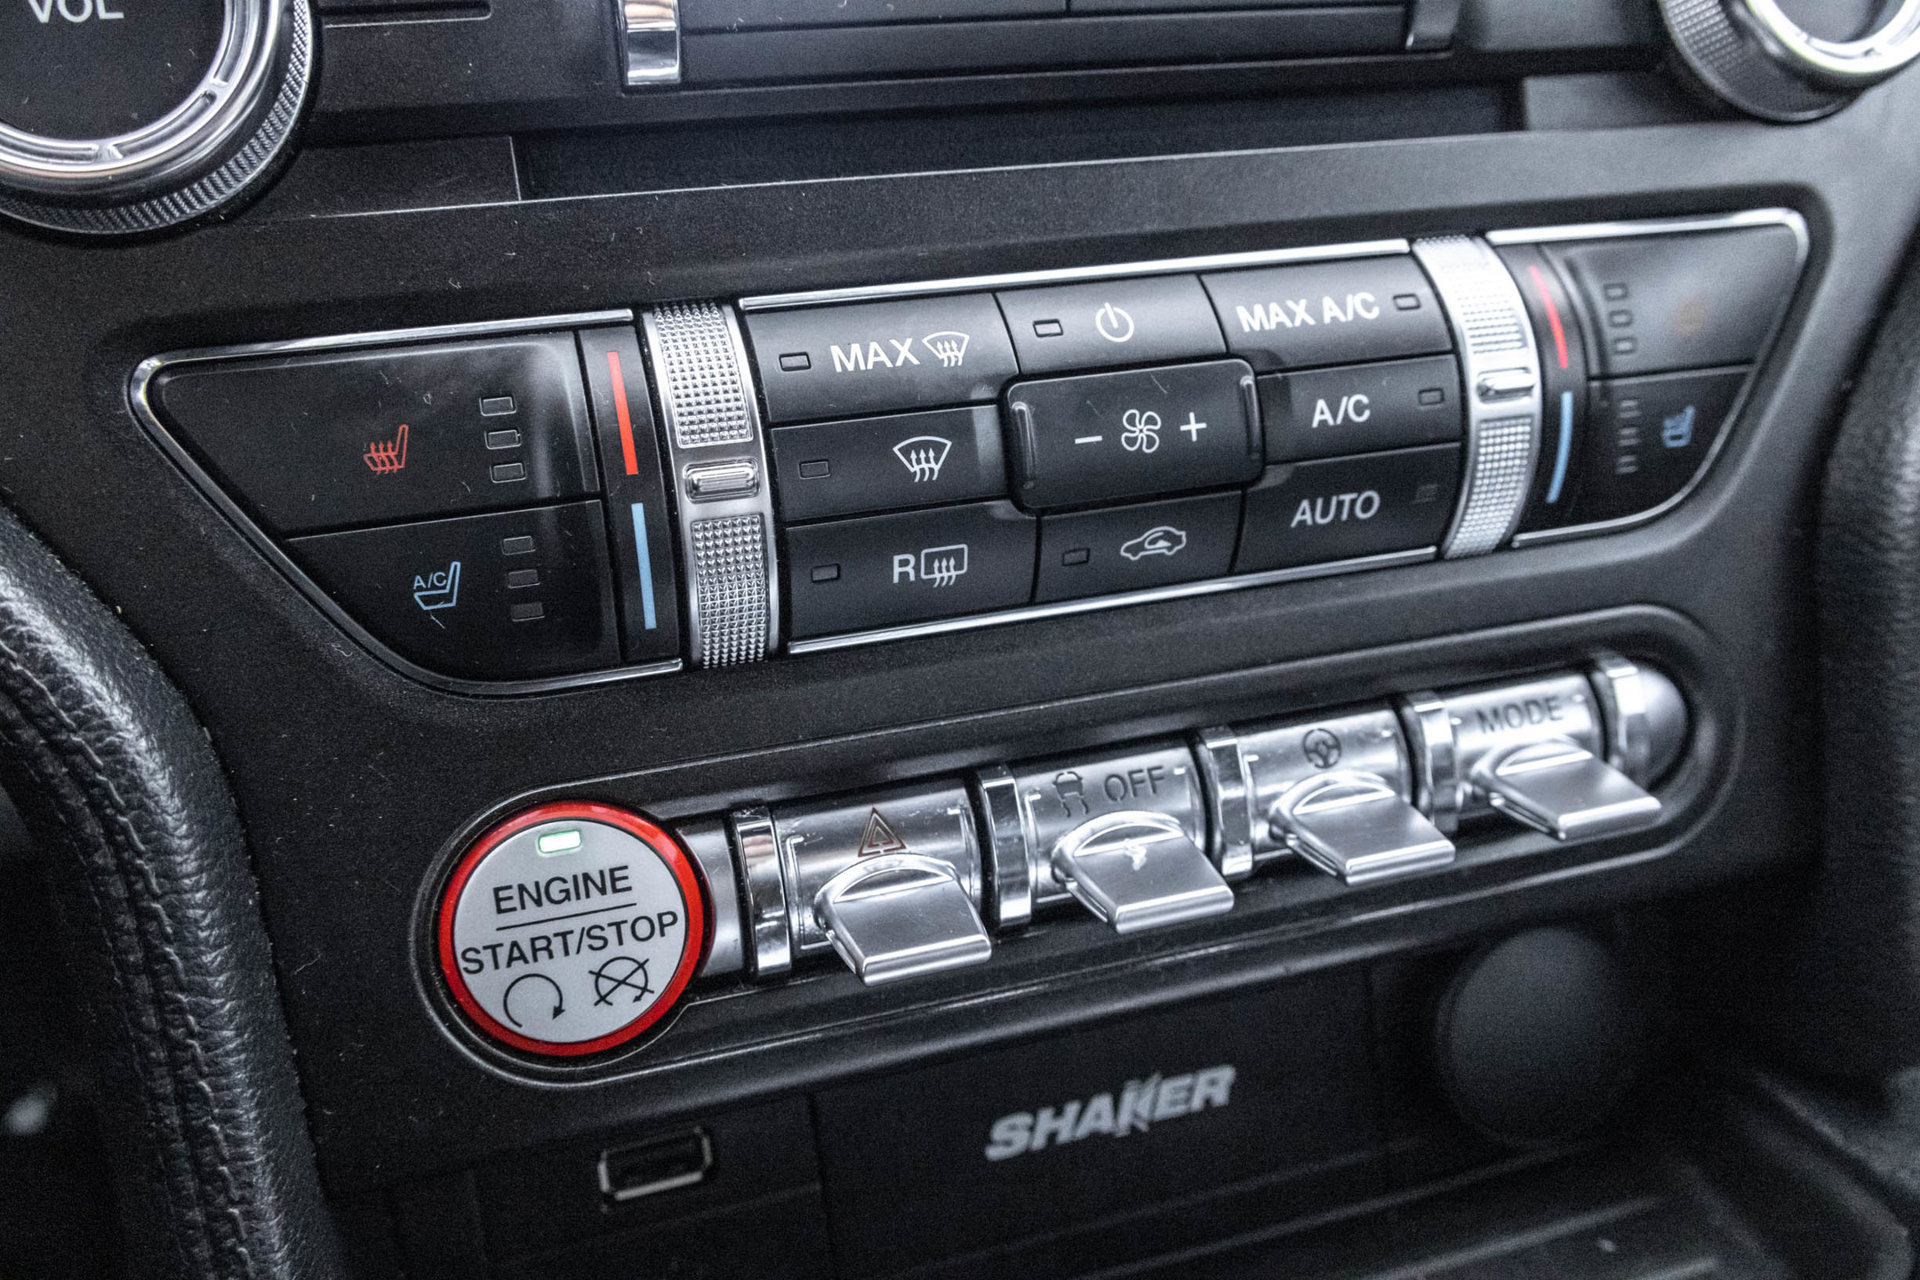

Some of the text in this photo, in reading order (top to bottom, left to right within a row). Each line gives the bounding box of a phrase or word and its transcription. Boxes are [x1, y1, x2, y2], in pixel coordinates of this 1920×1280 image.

[1236, 292, 1380, 332] MAX A/C
[830, 338, 920, 373] MAX
[1312, 394, 1370, 428] A/C
[1290, 490, 1381, 528] AUTO
[413, 571, 448, 589] A/C
[892, 554, 916, 583] R
[1476, 695, 1566, 735] MODE
[1104, 765, 1165, 802] OFF
[493, 865, 633, 914] ENGINE
[460, 911, 679, 975] START/STOP
[985, 1064, 1237, 1161] SHAKER
